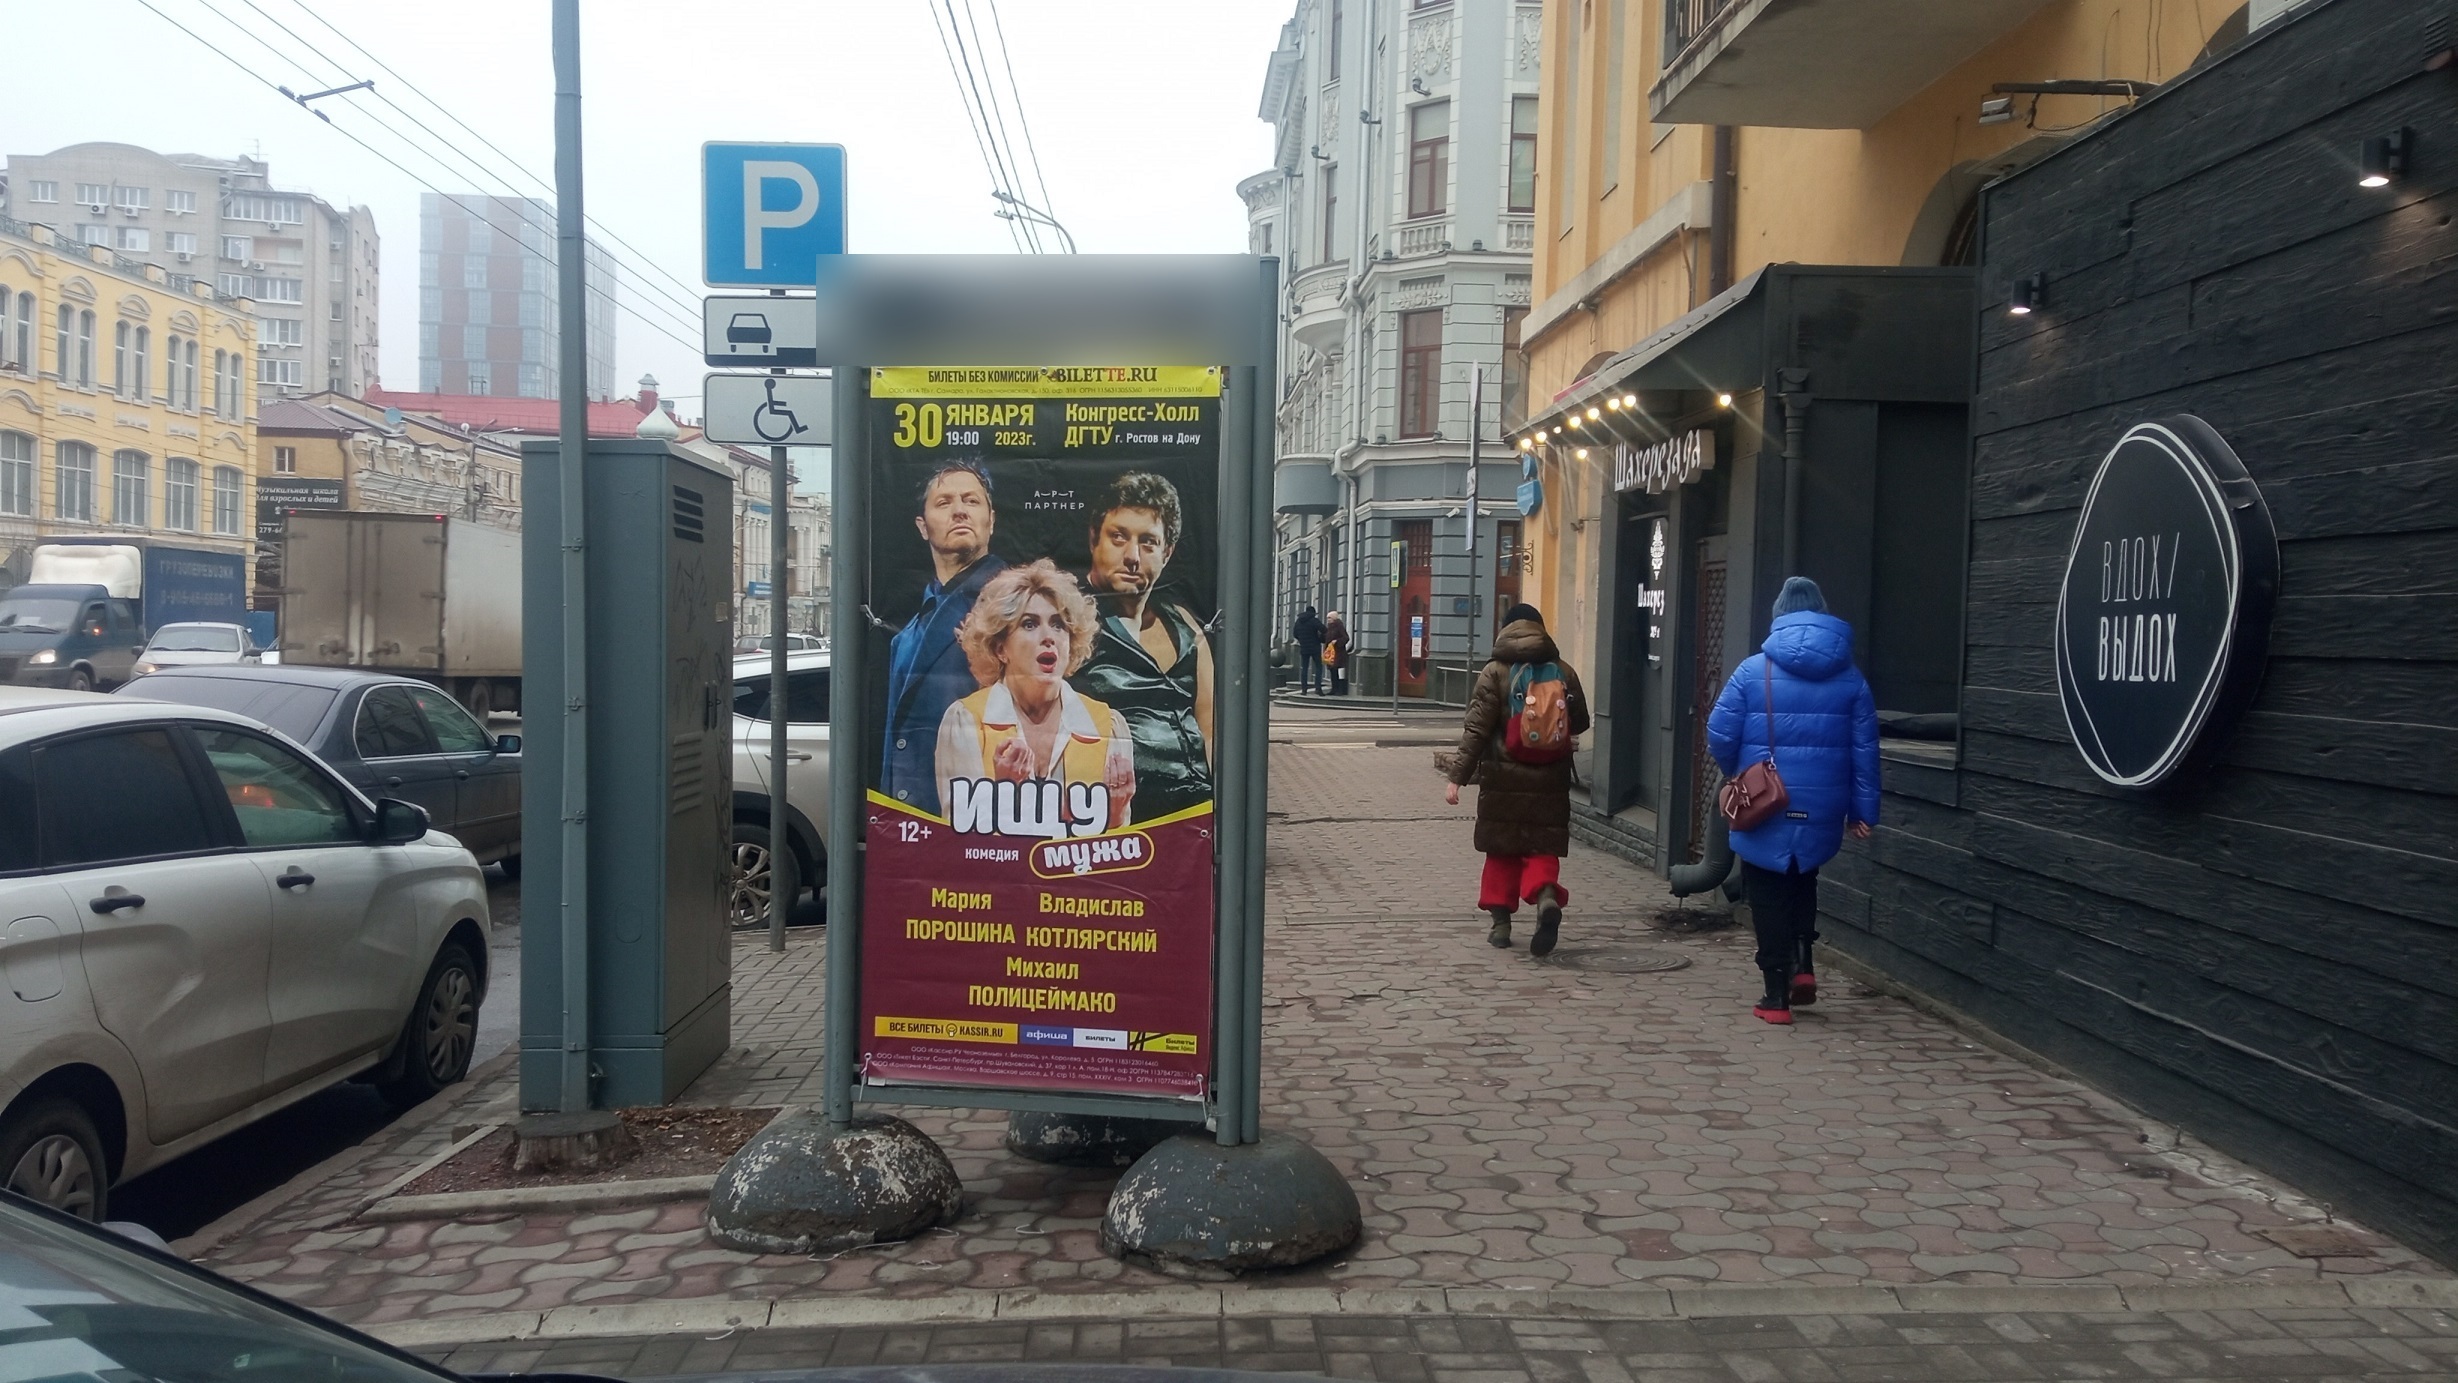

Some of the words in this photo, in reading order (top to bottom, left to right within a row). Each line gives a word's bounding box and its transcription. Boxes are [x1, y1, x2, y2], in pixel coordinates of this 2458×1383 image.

[743, 160, 820, 269] P
[928, 370, 967, 383] БИЛЕТЫ
[968, 370, 986, 383] БЕЗ
[987, 370, 1039, 383] КОМИССИИ
[1056, 367, 1158, 383] BILETTE.RU
[893, 402, 943, 448] 30
[945, 403, 1035, 427] ЯНВАРЯ
[1065, 402, 1200, 425] Конгресс-Холл
[945, 431, 980, 446] 19:00
[994, 431, 1037, 446] 2023г.
[1064, 426, 1114, 448] ДГТУ
[1115, 434, 1123, 444] г.
[1126, 432, 1159, 444] Ростов
[1162, 433, 1174, 444] на
[1176, 432, 1201, 446] Дону
[1614, 428, 1701, 495] Шахерезада
[1024, 501, 1085, 510] ПАРТНЕР
[2098, 613, 2177, 683] ВЫДОХ
[898, 820, 932, 843] 12+
[965, 846, 1020, 863] комедия
[1043, 836, 1142, 876] мужа
[931, 887, 992, 912] Мария
[1039, 892, 1144, 918] Владислав
[906, 919, 1016, 945] ПОРОШИНА
[1026, 925, 1158, 953] КОТЛЯРСКИЙ
[1006, 956, 1079, 980] Михаил
[968, 984, 1116, 1014] ПОЛИЦЕЙМАКО
[889, 1022, 906, 1032] ВСЕ
[907, 1023, 944, 1034] БИЛЕТЫ
[959, 1027, 1003, 1038] KASSIR.RU
[1026, 1029, 1068, 1041] афиша
